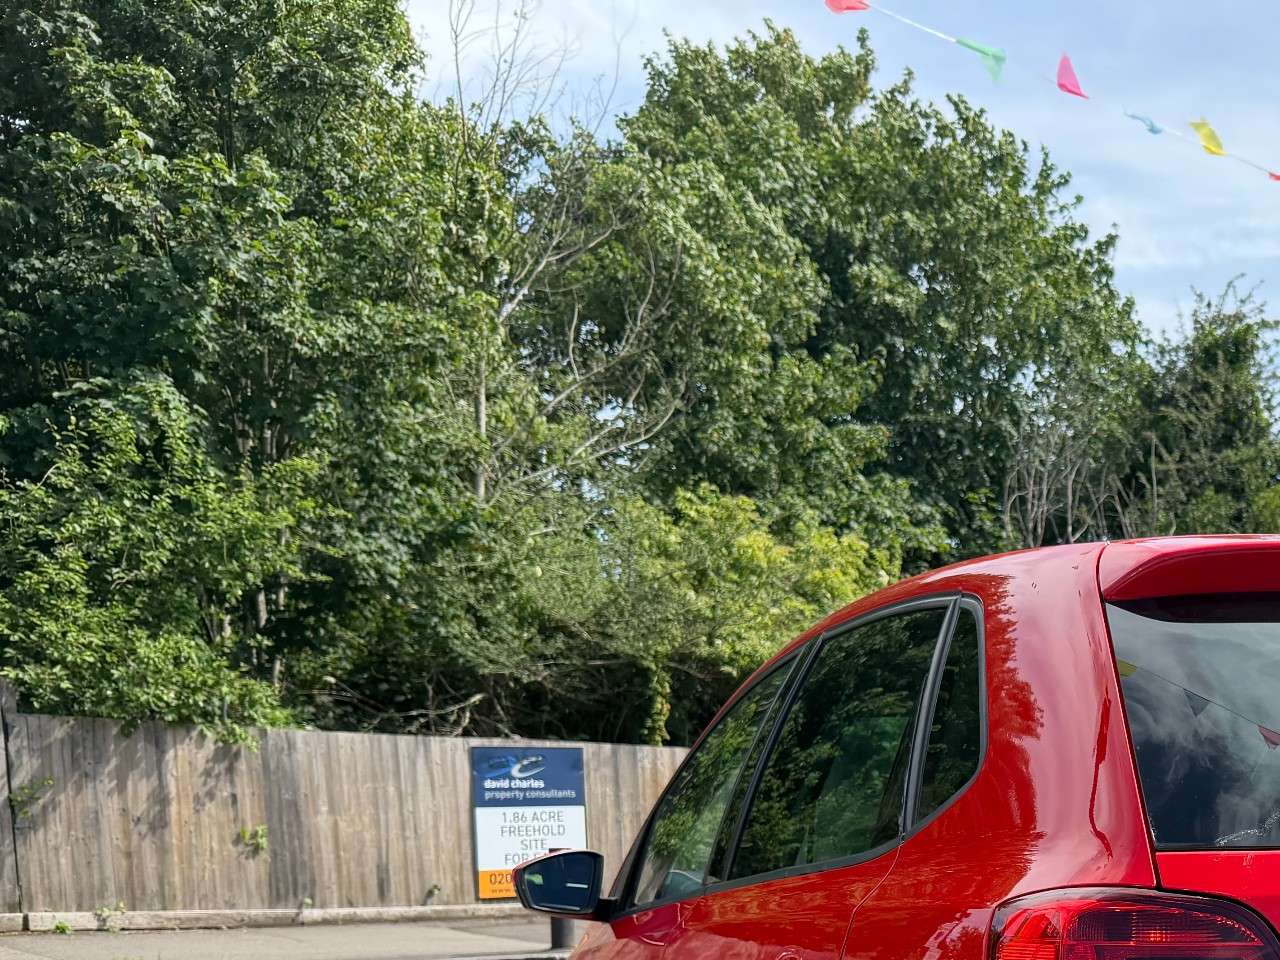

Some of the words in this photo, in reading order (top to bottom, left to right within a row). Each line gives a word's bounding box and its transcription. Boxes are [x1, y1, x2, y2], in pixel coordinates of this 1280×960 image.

[484, 778, 510, 788] david
[511, 778, 545, 788] charles
[485, 790, 524, 800] property
[525, 789, 576, 798] consultants
[502, 811, 528, 823] 1.86
[531, 811, 564, 822] ACRE
[500, 824, 566, 837] FREEHOLD
[520, 839, 548, 850] SITE
